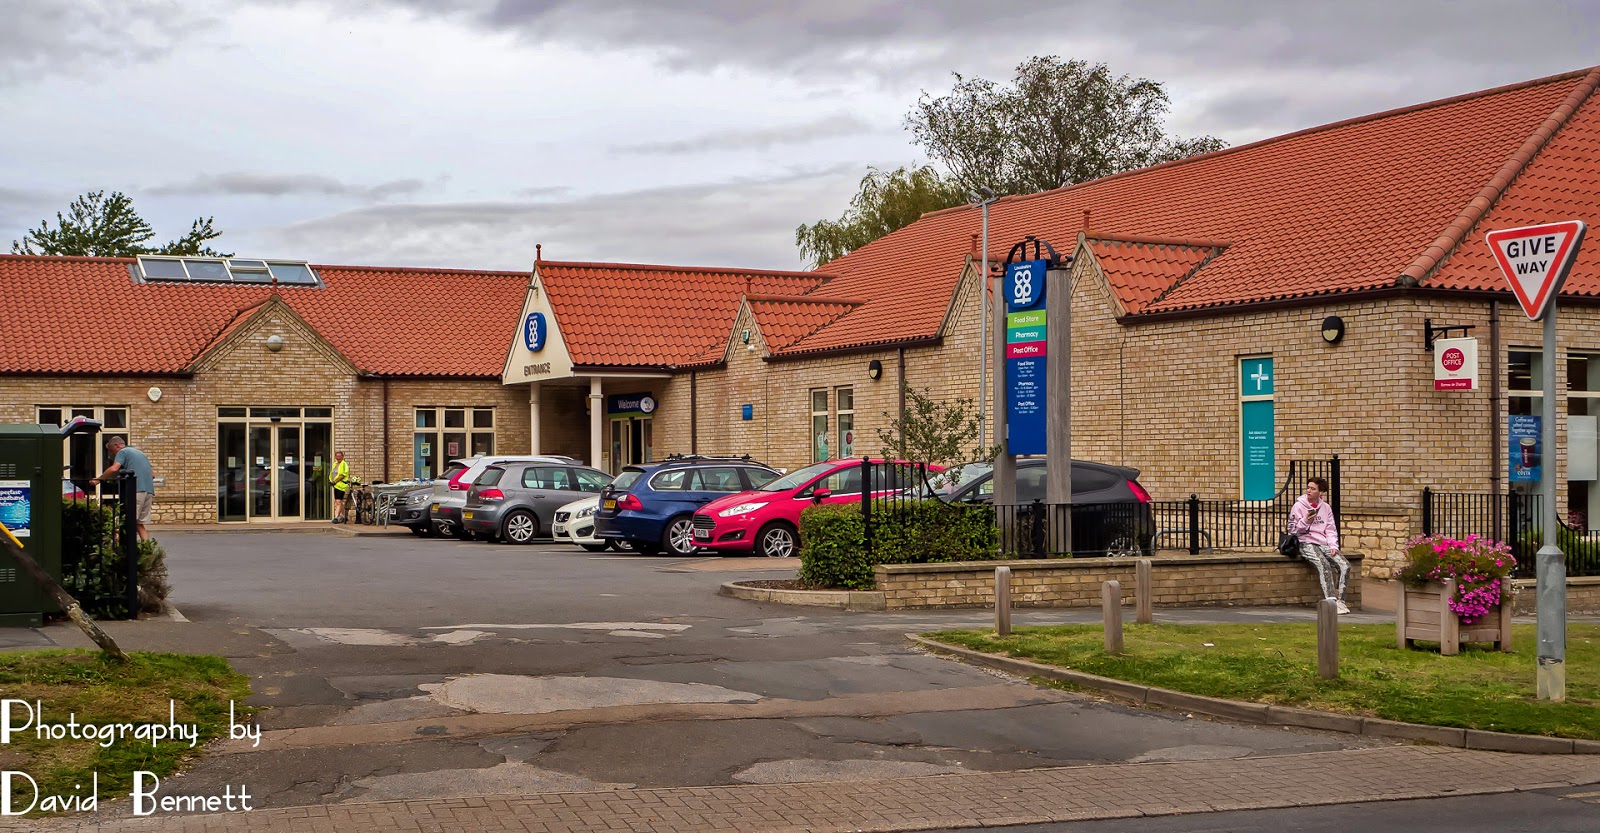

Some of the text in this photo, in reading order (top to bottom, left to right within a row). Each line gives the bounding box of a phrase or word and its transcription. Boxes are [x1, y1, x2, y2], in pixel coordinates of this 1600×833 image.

[1507, 236, 1556, 258] GIVE
[1516, 260, 1548, 275] WAY
[1013, 315, 1039, 324] Food Store
[1015, 331, 1039, 339] Pharmacy
[1024, 345, 1039, 353] Office
[523, 362, 551, 377] ENTRANCE
[617, 399, 640, 409] Welcome
